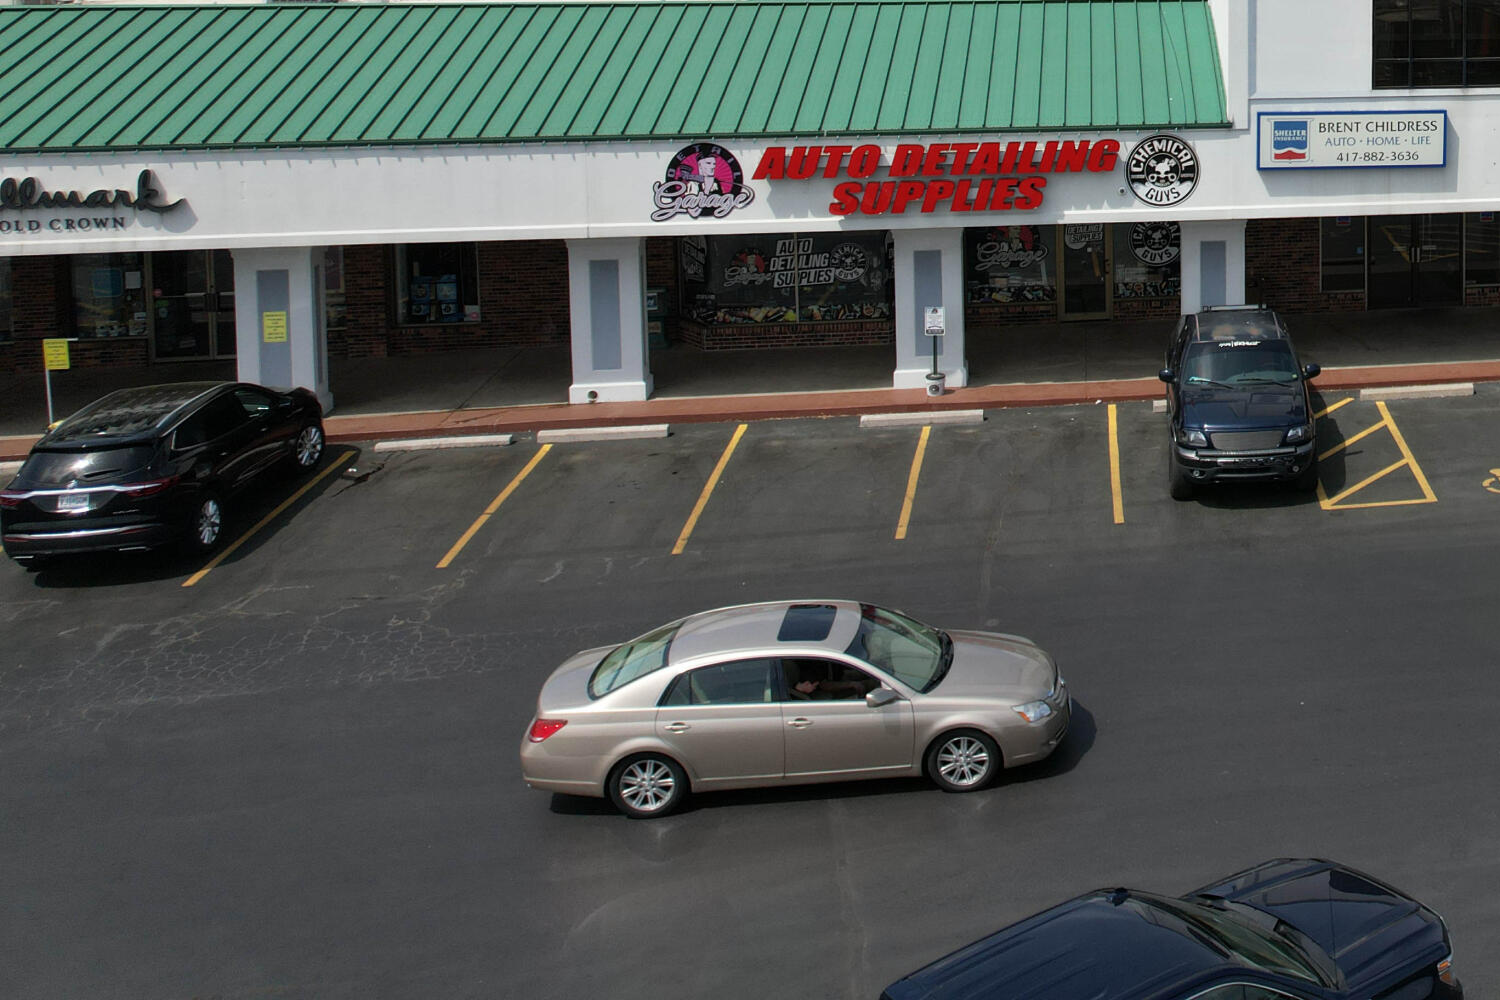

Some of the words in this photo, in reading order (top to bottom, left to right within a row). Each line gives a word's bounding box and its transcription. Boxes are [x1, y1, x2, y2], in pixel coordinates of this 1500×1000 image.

[1318, 121, 1361, 133] BRENT
[1365, 120, 1438, 132] CHILDRESS
[1325, 137, 1356, 146] AUTO
[1366, 136, 1400, 145] HOME
[1411, 135, 1431, 145] LIFE
[752, 145, 883, 180] AUTO
[888, 139, 1120, 177] DETAILING
[1131, 139, 1194, 172] CHEMICAL
[1336, 151, 1419, 162] 417-882-3636
[0, 169, 187, 212] llmark
[828, 176, 1047, 215] SUPPLIES
[1145, 187, 1181, 202] GUYS
[651, 181, 755, 221] Garage
[49, 217, 125, 230] CROWN
[780, 239, 811, 254] AUTO
[770, 252, 830, 271] DETAILING
[1142, 250, 1172, 261] GUYS
